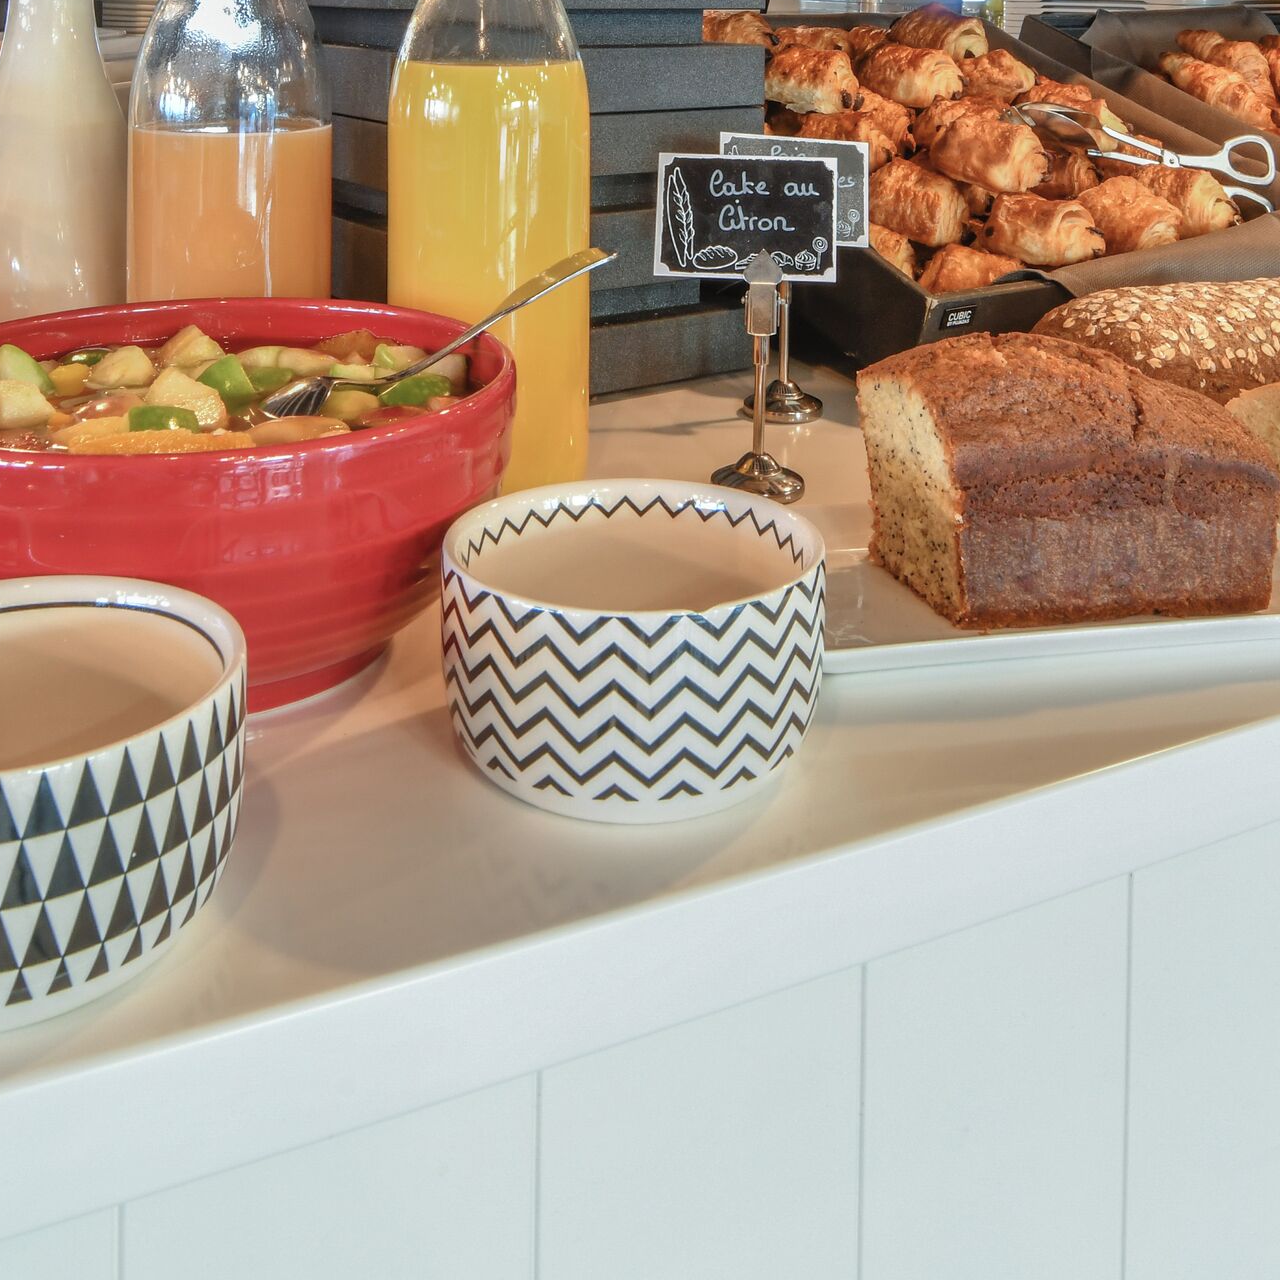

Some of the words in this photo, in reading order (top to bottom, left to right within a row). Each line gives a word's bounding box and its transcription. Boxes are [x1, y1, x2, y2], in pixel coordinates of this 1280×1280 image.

[709, 169, 770, 197] Cake
[783, 181, 820, 197] au
[718, 198, 796, 231] Citron
[948, 310, 972, 322] CUBIC
